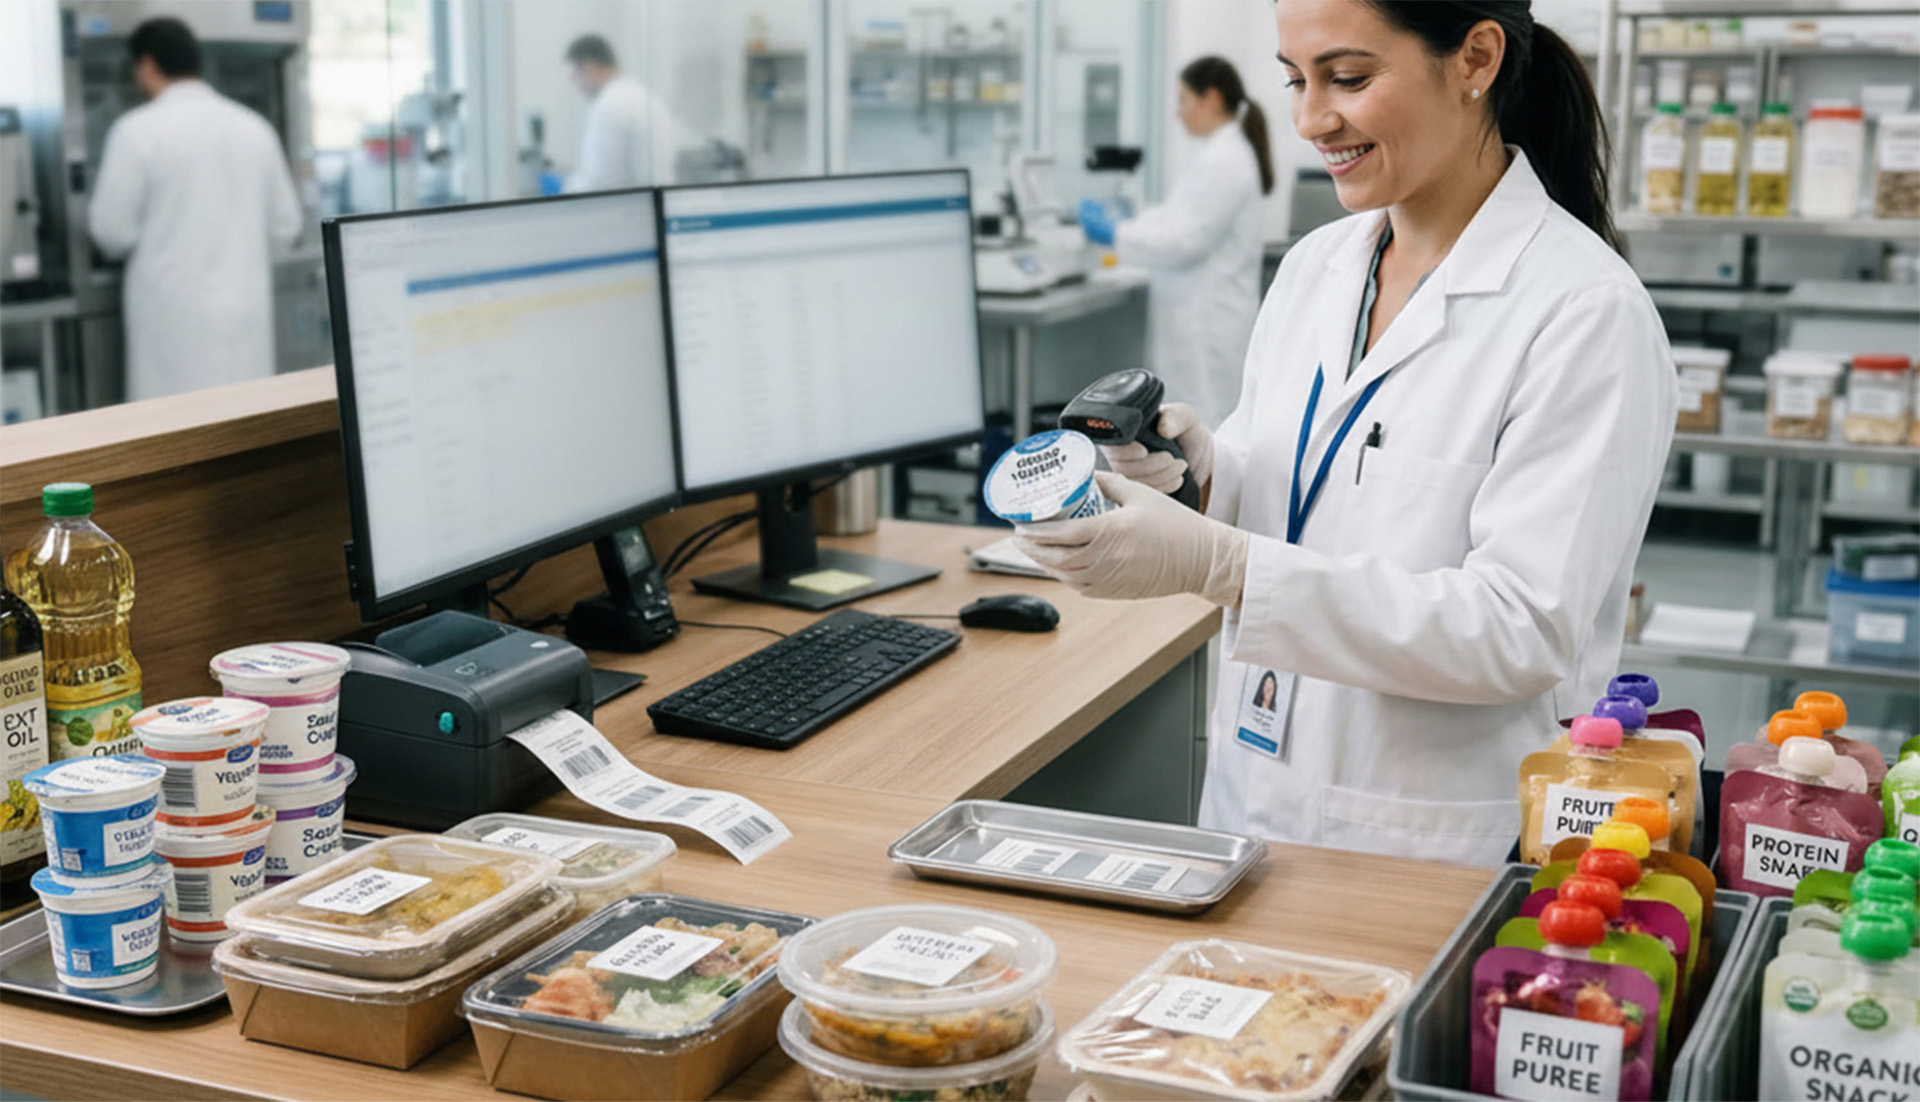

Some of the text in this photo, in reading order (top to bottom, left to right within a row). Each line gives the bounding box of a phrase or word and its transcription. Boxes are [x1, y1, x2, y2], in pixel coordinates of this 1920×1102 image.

[3, 707, 37, 731] EXT
[7, 727, 39, 748] OIL
[1752, 834, 1840, 865] PROTEIN
[1521, 1032, 1600, 1065] FRUIT
[1512, 1059, 1601, 1095] PUREE
